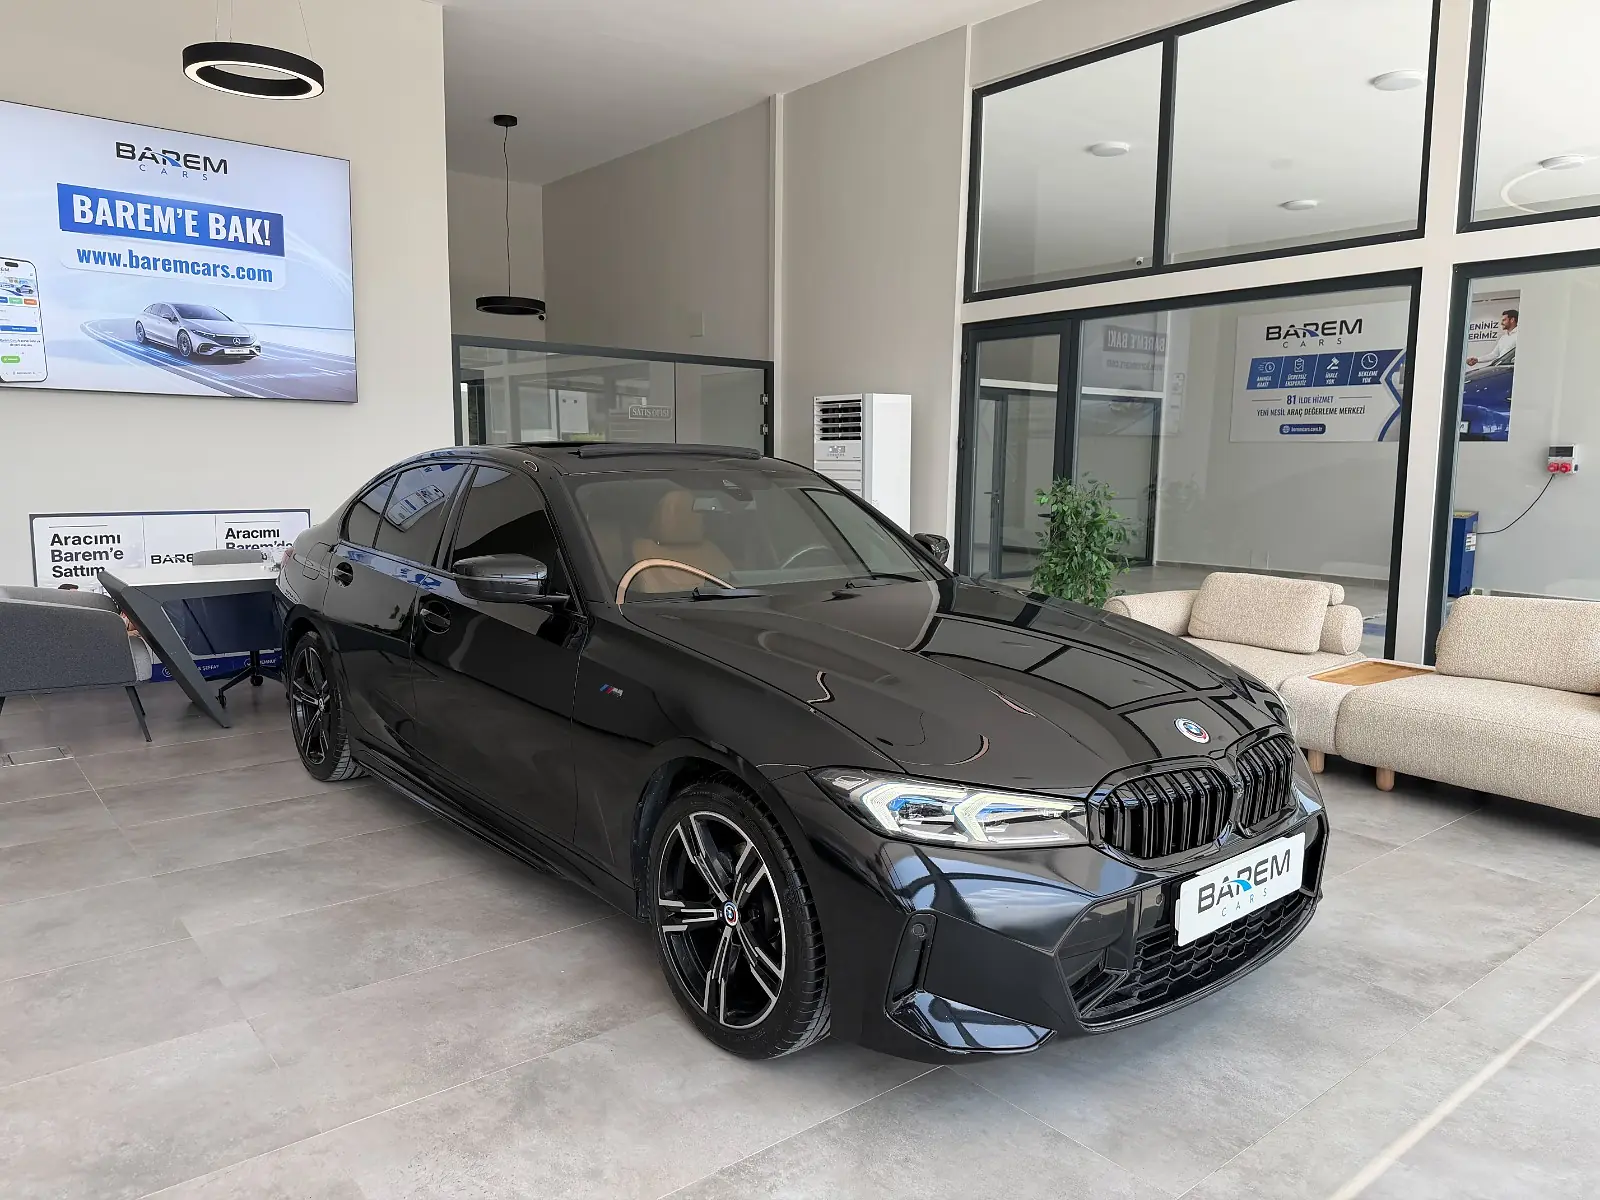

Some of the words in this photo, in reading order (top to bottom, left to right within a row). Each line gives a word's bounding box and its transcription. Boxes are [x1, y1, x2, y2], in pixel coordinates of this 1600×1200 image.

[116, 141, 228, 175] BAREM
[139, 164, 208, 181] CARS
[72, 193, 200, 238] BAREM'E
[208, 212, 271, 246] BAK!
[76, 248, 273, 283] www.baremcars.com
[1265, 318, 1363, 341] BAREM
[1469, 321, 1499, 331] ENİNİZ
[1468, 331, 1498, 340] ERİMİZ
[1282, 337, 1342, 349] CARS
[1286, 395, 1296, 405] 81
[1312, 394, 1334, 404] HİZMET
[1257, 408, 1269, 417] YENİ
[1270, 408, 1285, 416] NESİL
[1287, 408, 1302, 418] ARAÇ
[1304, 407, 1337, 416] DEĞERLEME
[1339, 405, 1365, 415] MERKEZİ
[50, 533, 121, 546] Aracımı
[225, 527, 280, 540] Aracımı
[50, 547, 124, 563] Barem'e
[151, 553, 194, 565] BARE
[1198, 848, 1291, 914] BAREM
[1221, 887, 1268, 917] CARS
